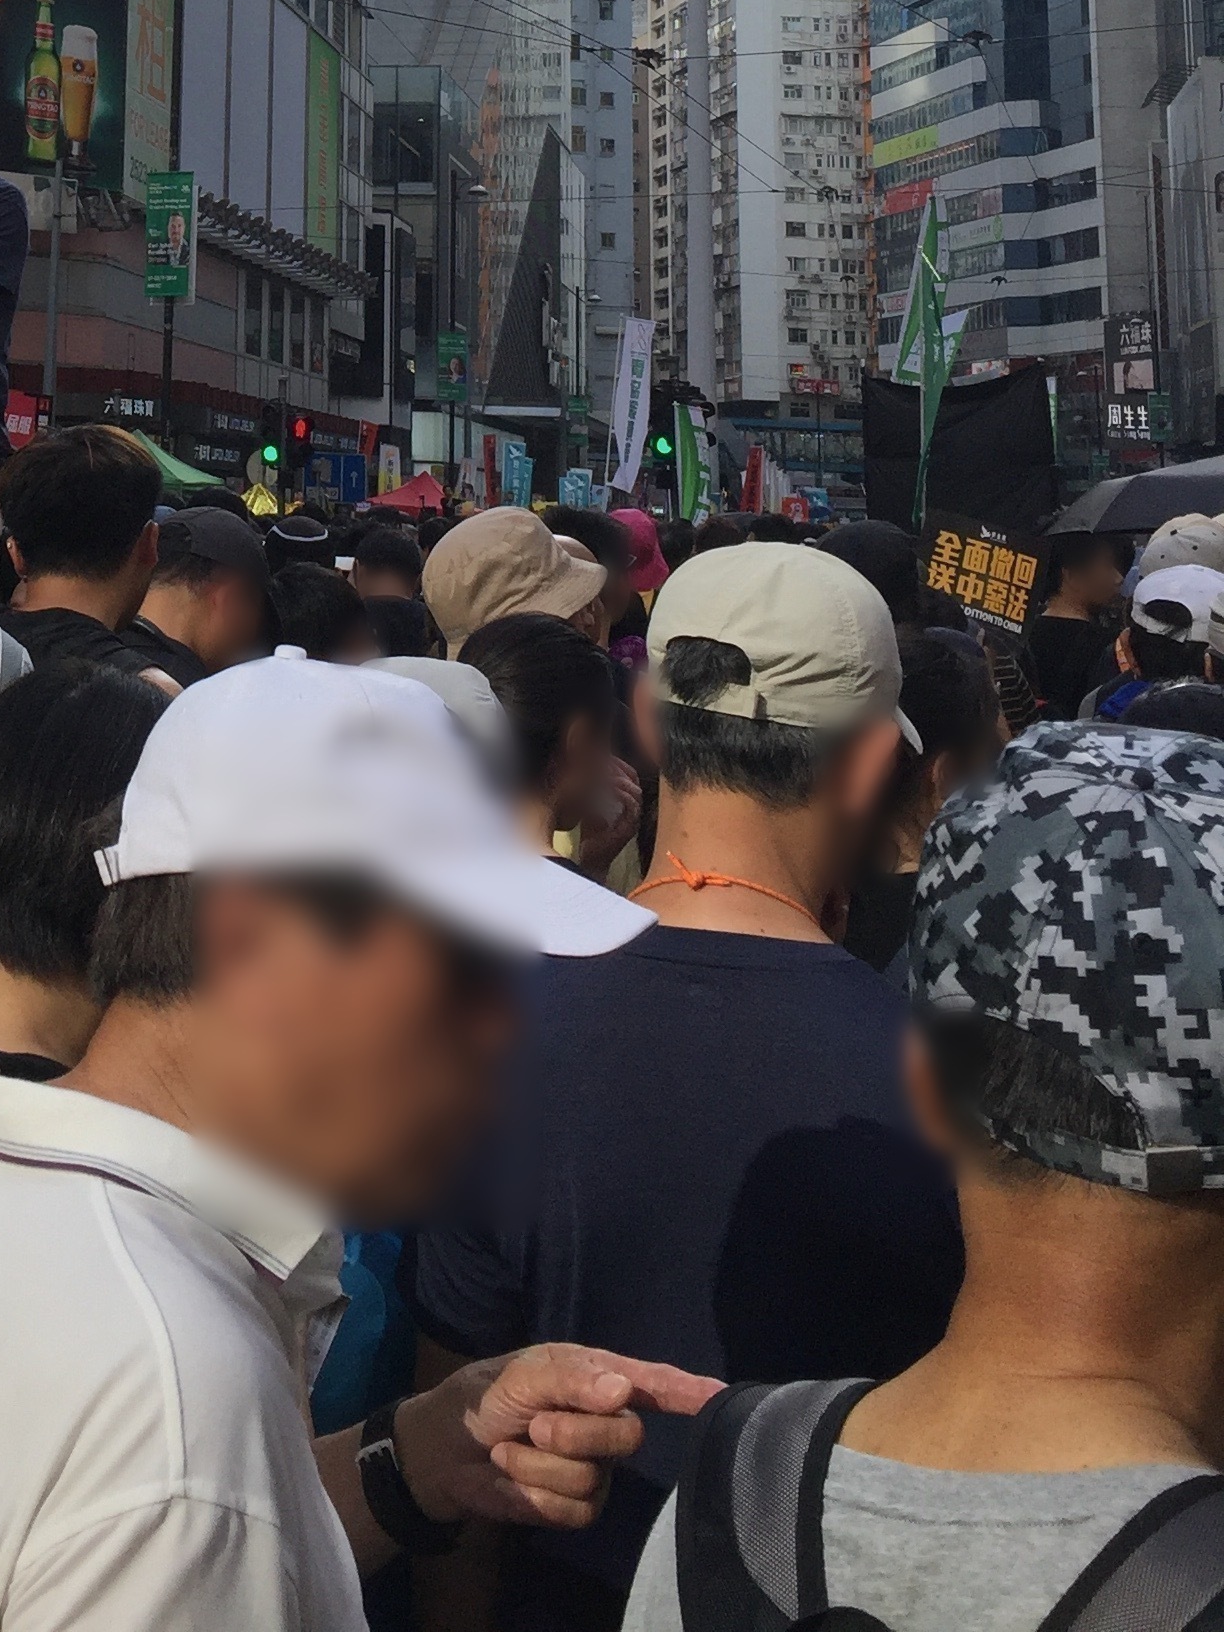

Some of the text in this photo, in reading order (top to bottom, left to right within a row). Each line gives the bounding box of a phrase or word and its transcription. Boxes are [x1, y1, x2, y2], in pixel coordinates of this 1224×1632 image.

[1107, 403, 1150, 430] 周生生
[931, 529, 1038, 590] 全面撤回
[926, 560, 1029, 623] 送中惡法
